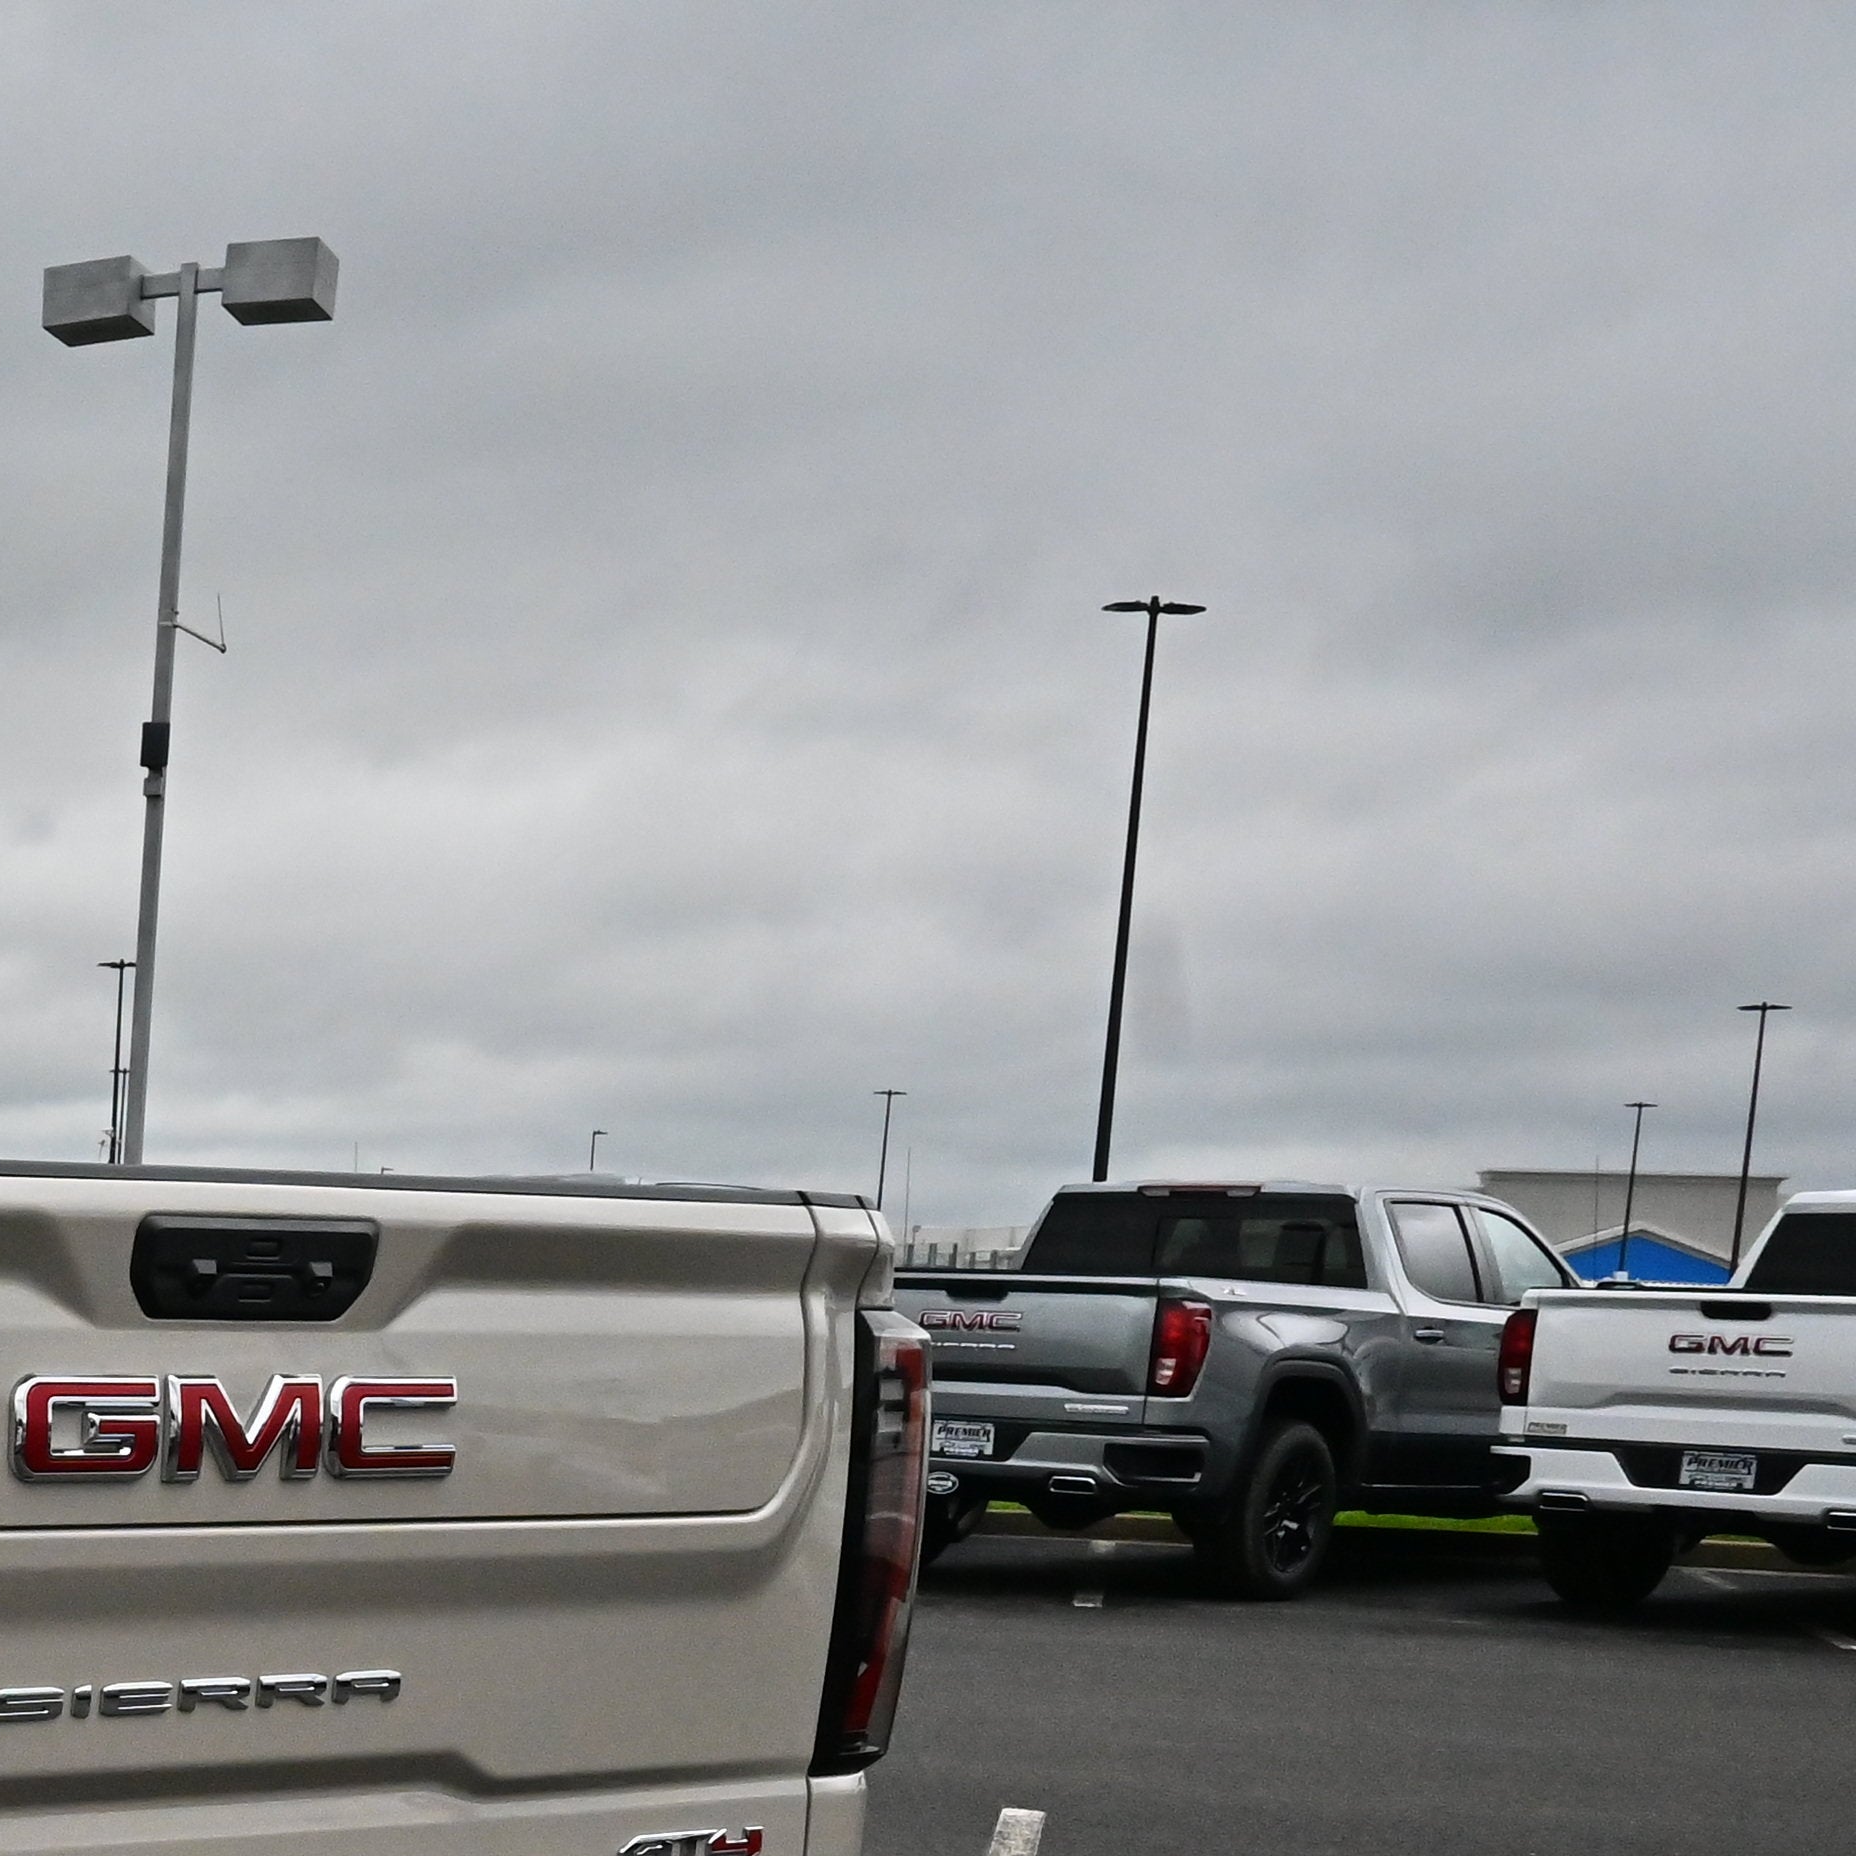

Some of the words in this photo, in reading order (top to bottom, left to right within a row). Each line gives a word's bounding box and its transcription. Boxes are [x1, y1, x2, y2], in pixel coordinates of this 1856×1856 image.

[919, 1310, 1023, 1333] GMC
[1668, 1333, 1794, 1358] GMC
[8, 1373, 458, 1484] GMC
